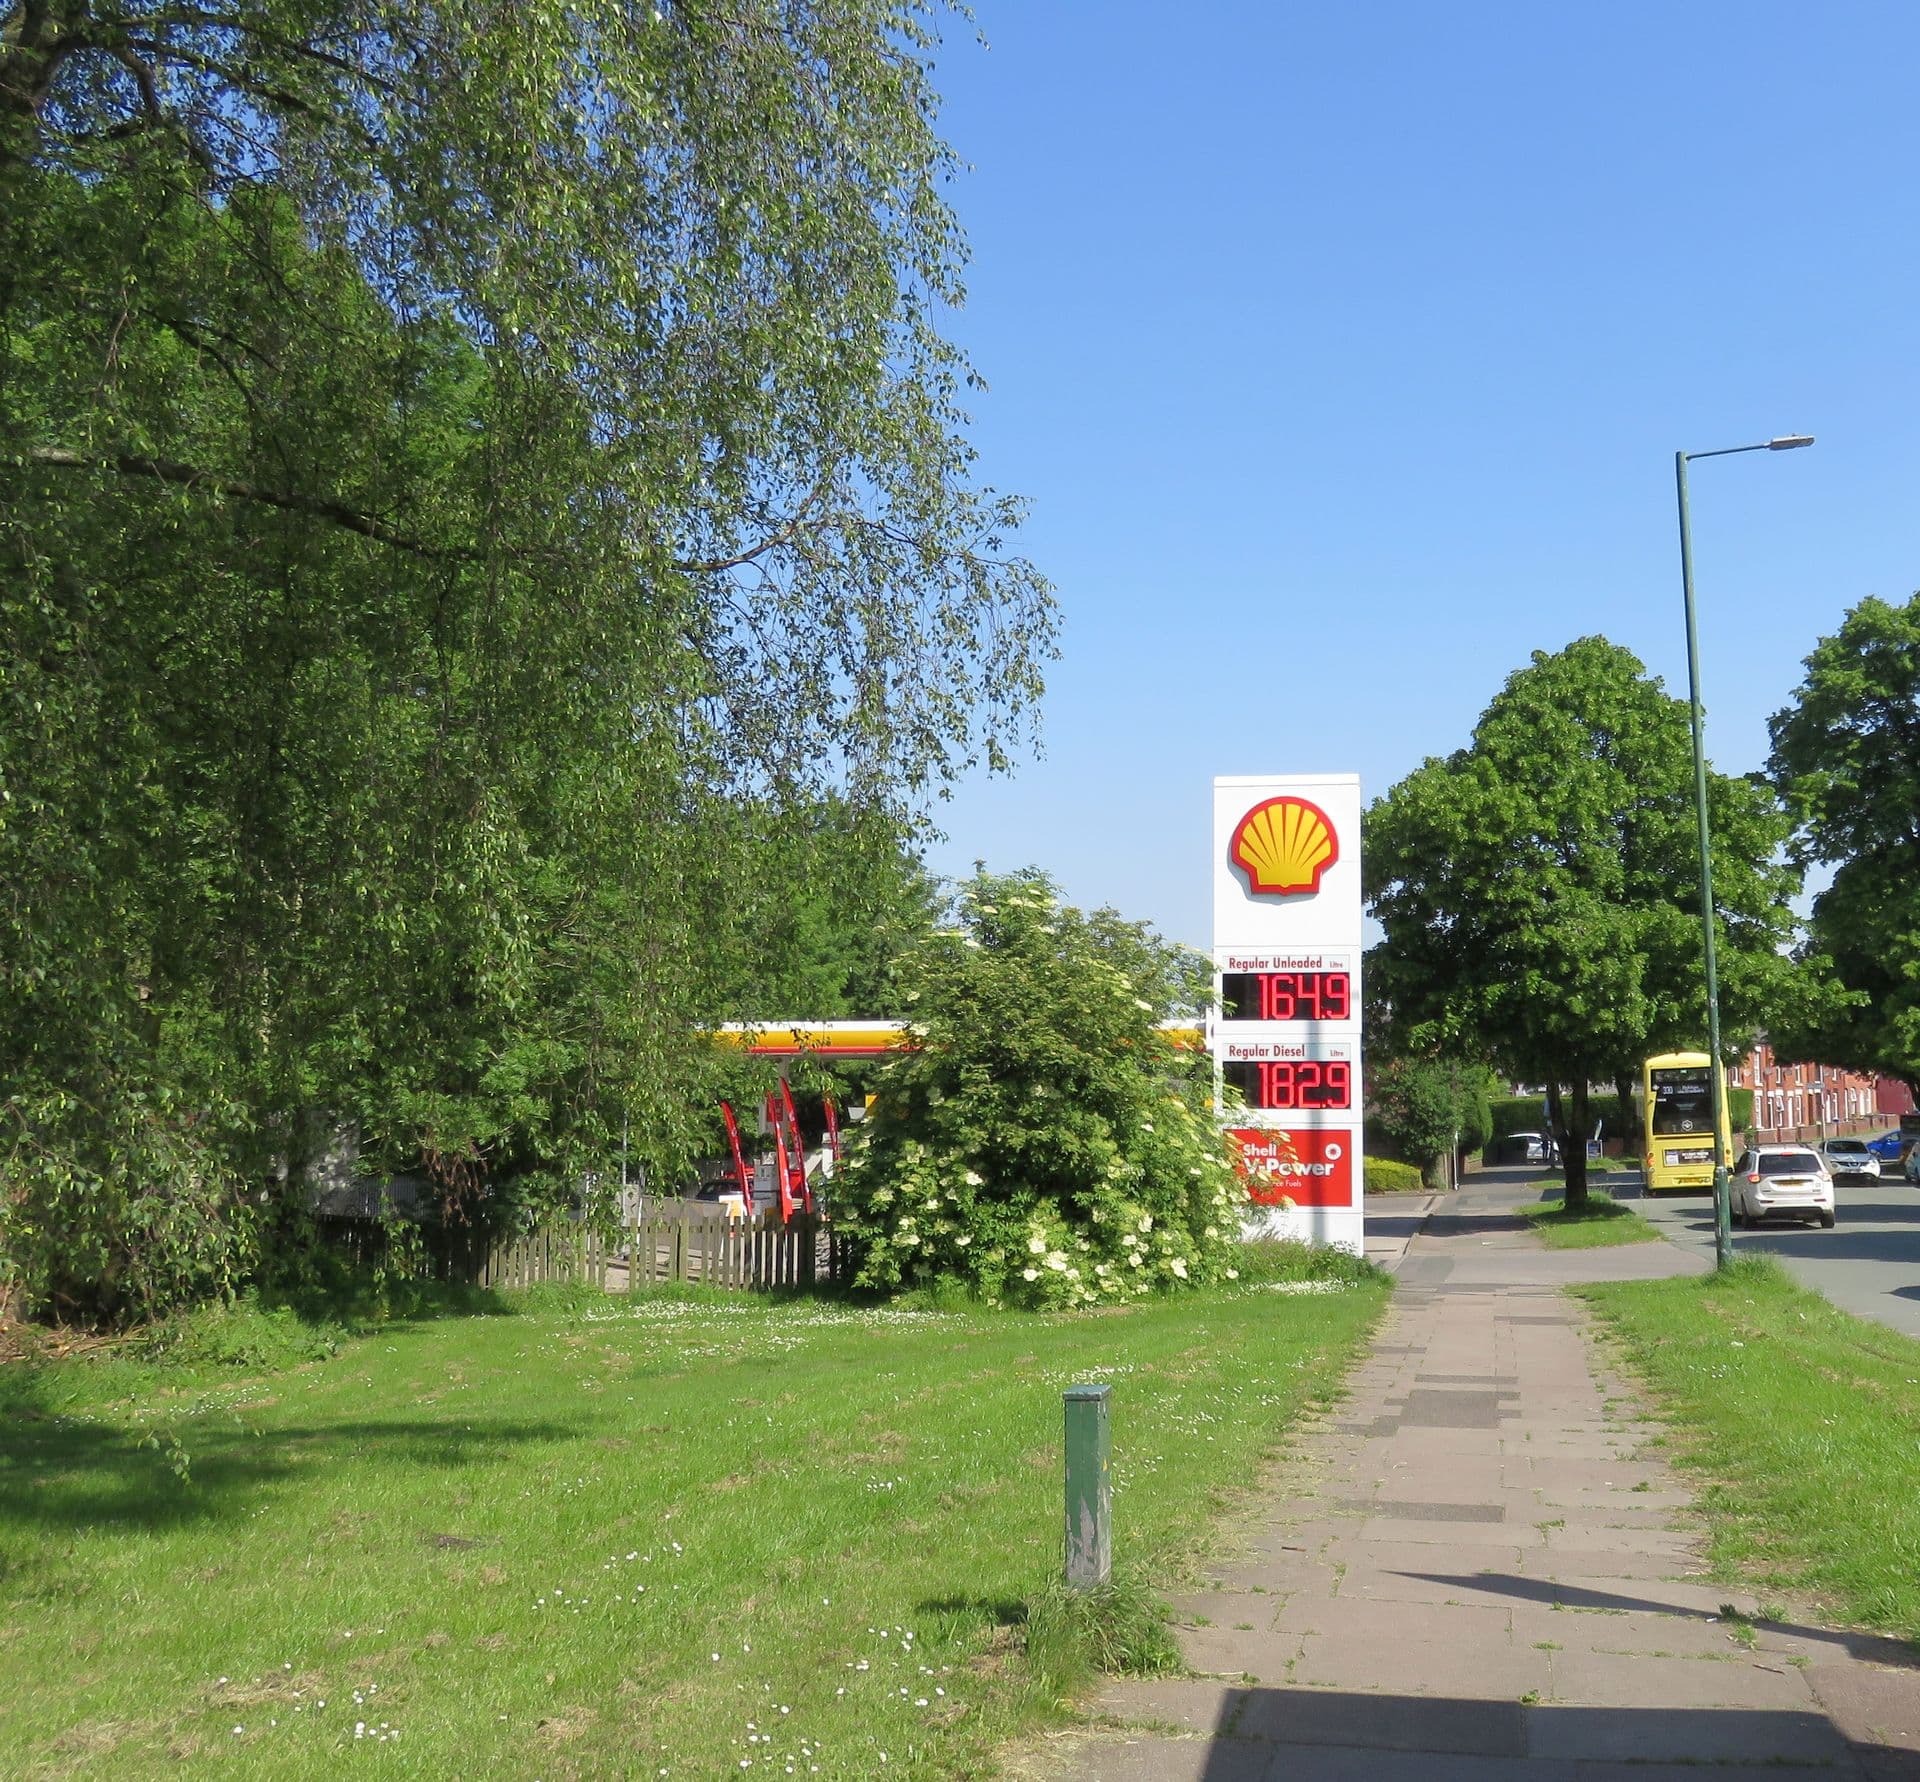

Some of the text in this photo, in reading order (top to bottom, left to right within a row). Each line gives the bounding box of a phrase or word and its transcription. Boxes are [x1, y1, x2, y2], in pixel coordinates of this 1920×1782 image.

[1229, 957, 1269, 972] Regular
[1273, 956, 1322, 969] Unleaded
[1258, 974, 1349, 1020] 164.9
[1229, 1045, 1344, 1060] Regular Diesel Litre
[1258, 1063, 1350, 1108] 182.9
[1242, 1143, 1277, 1157] Shell
[1243, 1158, 1335, 1176] V-Power
[1285, 1179, 1302, 1187] Fuels
